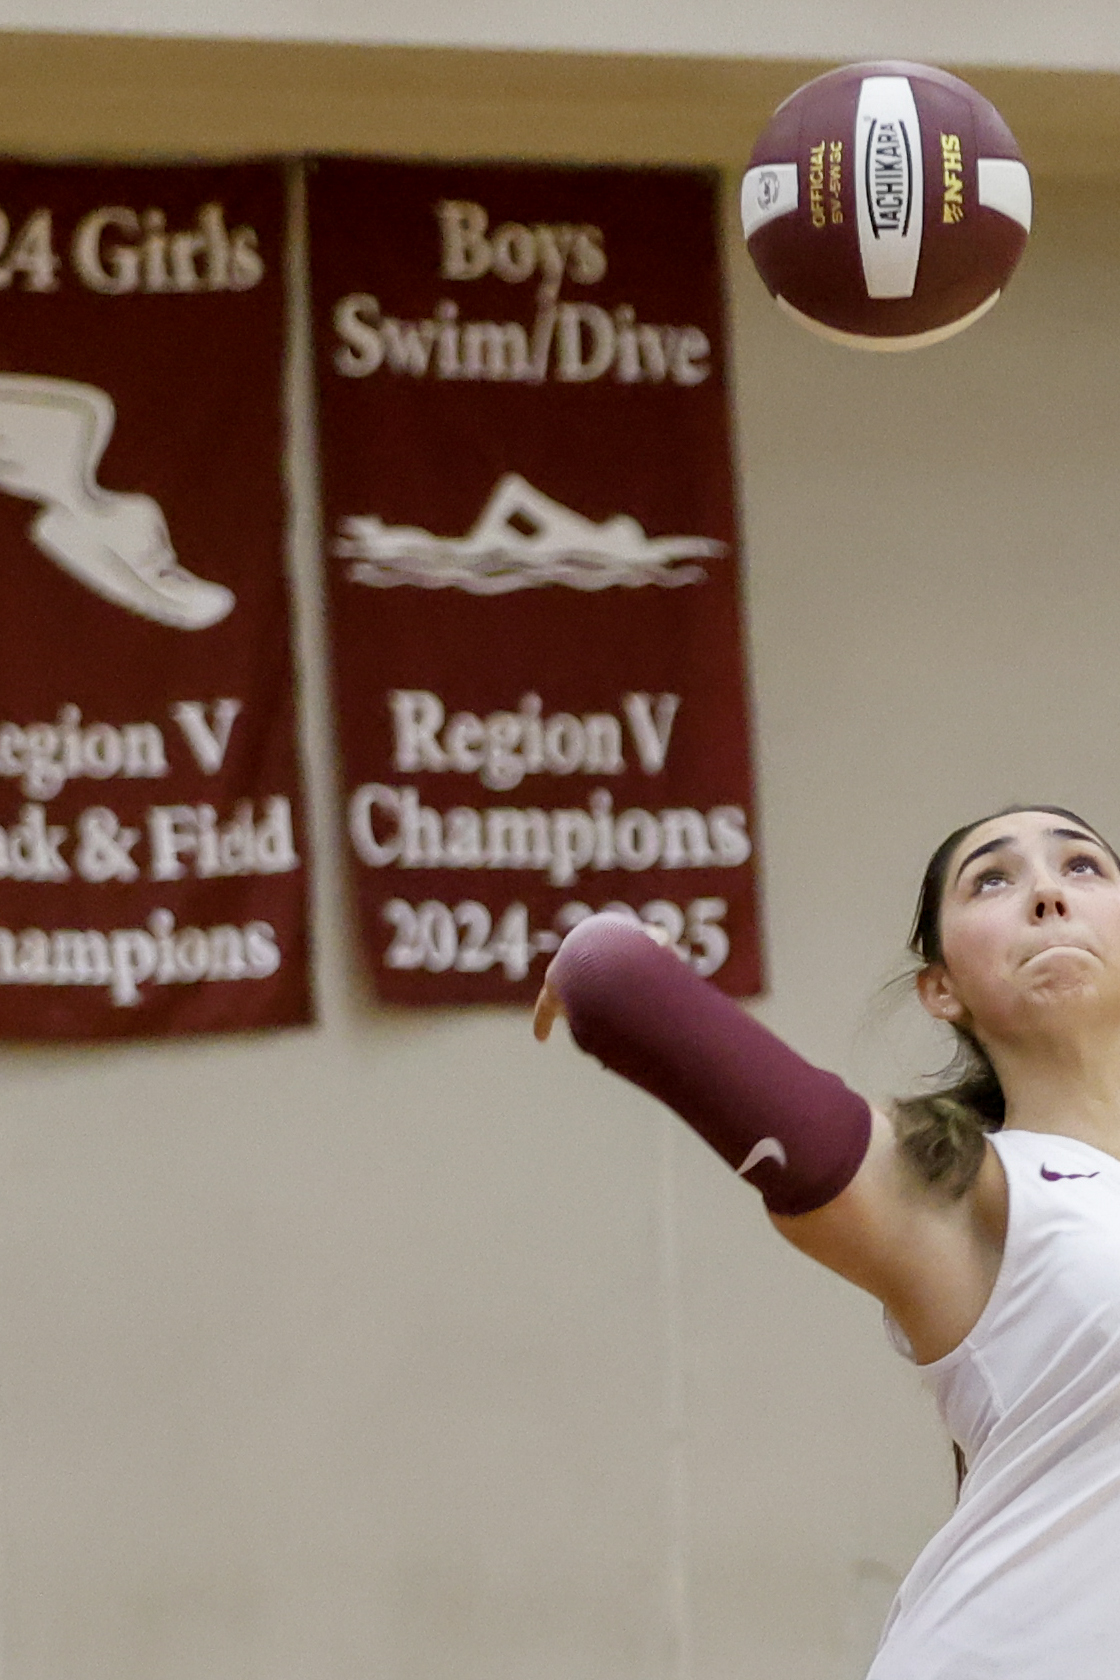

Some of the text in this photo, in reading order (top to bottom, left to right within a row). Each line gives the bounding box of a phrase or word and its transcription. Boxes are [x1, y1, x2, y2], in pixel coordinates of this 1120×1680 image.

[808, 139, 826, 228] OFFICIAL
[873, 122, 904, 233] TACHIKARA
[940, 131, 964, 204] NFHS
[0, 202, 265, 295] 4 Girls
[436, 199, 608, 307] Boys
[333, 292, 711, 386] Swim/Dive
[170, 697, 243, 775] V
[388, 689, 681, 792] Region V
[75, 804, 141, 884] &
[349, 782, 752, 888] Champions
